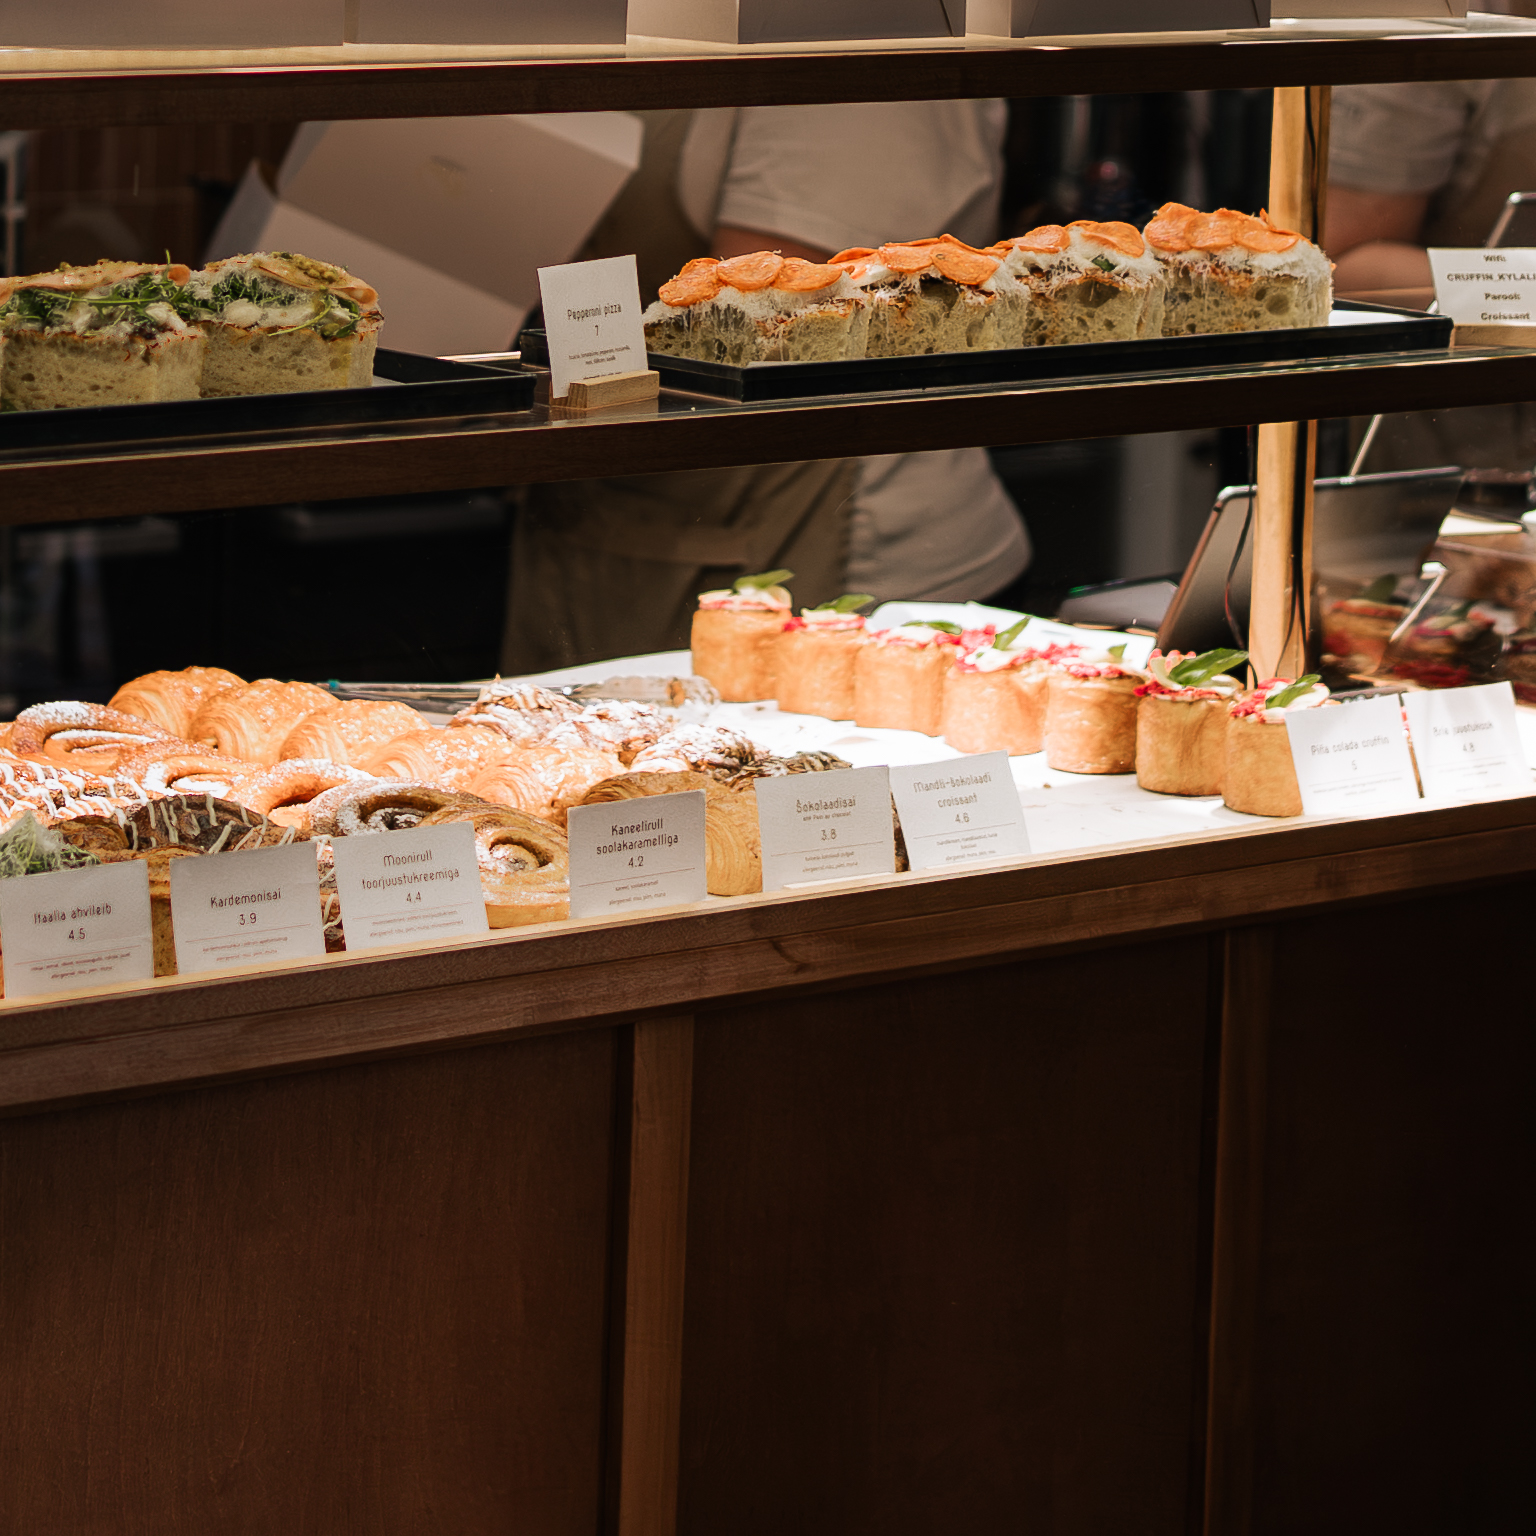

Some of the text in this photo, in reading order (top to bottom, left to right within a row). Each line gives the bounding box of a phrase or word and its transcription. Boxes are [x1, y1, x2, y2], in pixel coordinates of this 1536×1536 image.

[567, 301, 622, 322] Pepperoni pizza
[1480, 312, 1531, 321] Croissant
[796, 795, 856, 813] Šokolaadisai
[937, 792, 979, 808] croissant
[611, 817, 664, 836] Kaneelirull
[820, 828, 838, 841] 3.8
[596, 834, 679, 855] soolakaramelliga
[383, 849, 433, 867] Moonirull
[628, 855, 644, 868] 4.2
[361, 868, 460, 890] toorjuustukreemiga
[210, 887, 282, 909] Kardemonisai
[406, 891, 422, 903] 4.4
[33, 902, 113, 925] Itaalia ahvileib
[239, 912, 257, 926] 3.9
[68, 927, 86, 941] 4.5
